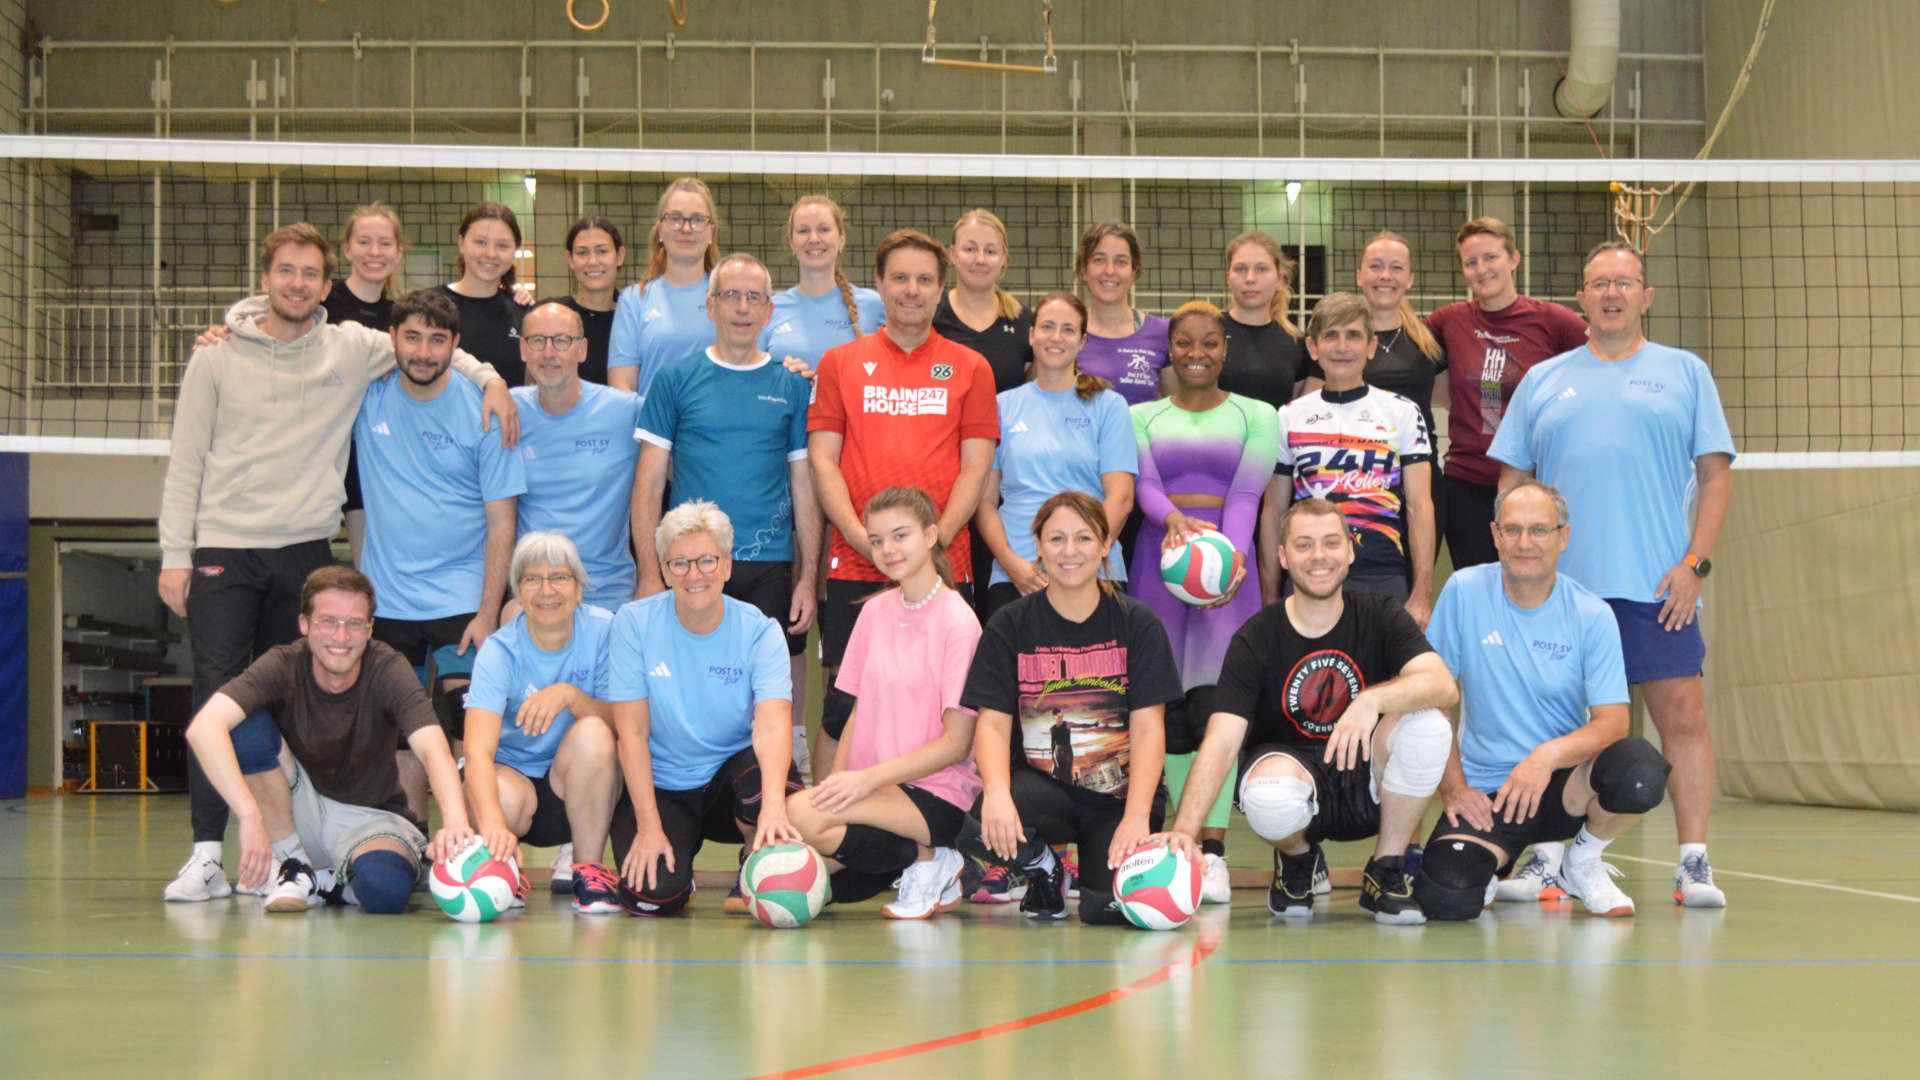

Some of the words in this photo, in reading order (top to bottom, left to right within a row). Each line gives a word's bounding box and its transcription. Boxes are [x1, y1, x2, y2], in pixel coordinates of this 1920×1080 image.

[1484, 347, 1507, 369] HH
[933, 365, 952, 377] 96
[1481, 367, 1504, 382] HALF
[863, 385, 919, 403] BRAIN
[920, 389, 945, 401] 247
[863, 398, 918, 416] HOUSE
[575, 439, 597, 447] POST
[1296, 448, 1396, 477] 24H
[1341, 469, 1392, 491] Rollers
[1532, 639, 1557, 651] POST
[1560, 644, 1573, 653] SV
[709, 665, 732, 675] POST
[1289, 665, 1309, 713] TWENTY
[1311, 658, 1336, 670] FIVE
